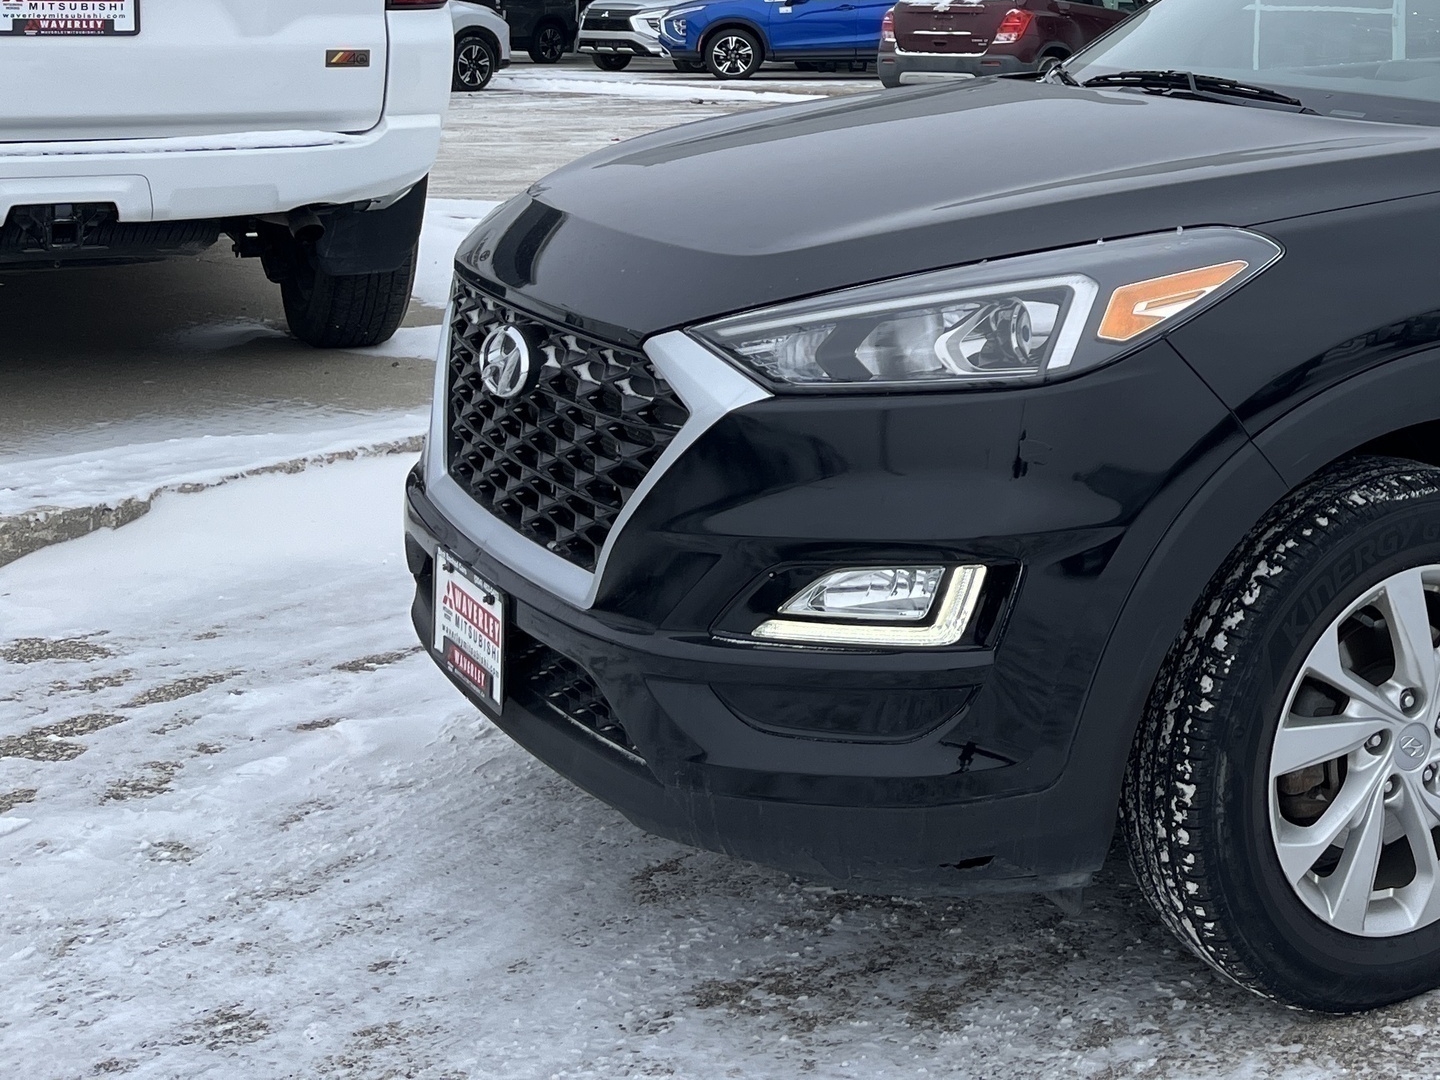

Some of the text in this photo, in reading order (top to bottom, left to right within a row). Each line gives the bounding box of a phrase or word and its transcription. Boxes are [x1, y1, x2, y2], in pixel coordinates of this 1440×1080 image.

[2, 12, 126, 20] waverleymitsubishi.com
[28, 2, 125, 11] MITSUBISHI
[40, 19, 104, 29] WAVERLEY
[454, 587, 500, 644] WAVERLEY
[454, 613, 500, 664] MITSUBISHI
[454, 649, 486, 687] WAVERLEY
